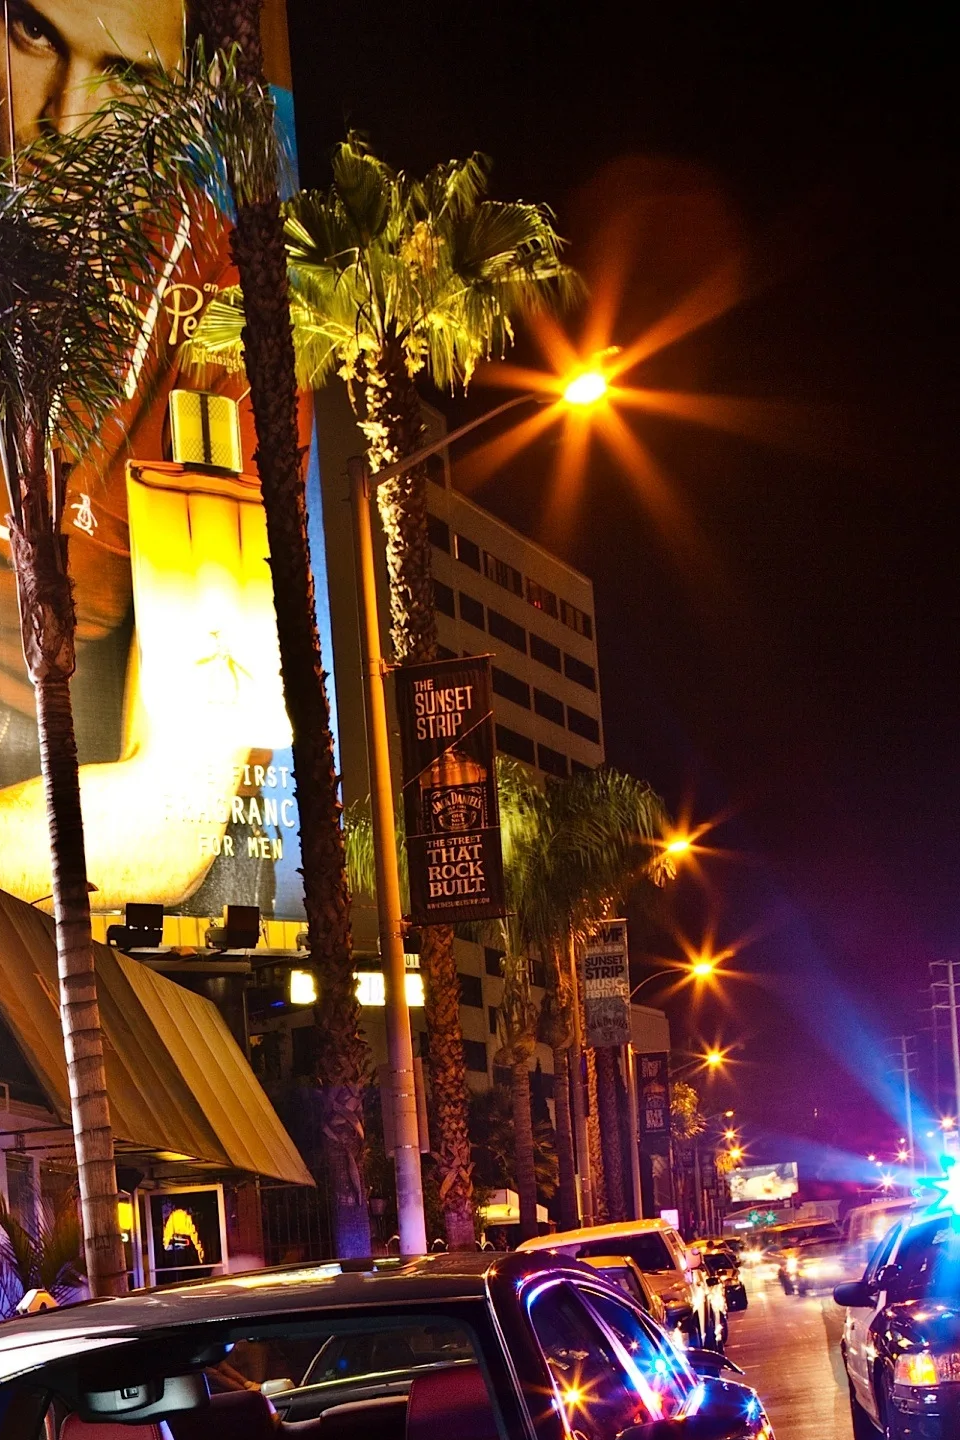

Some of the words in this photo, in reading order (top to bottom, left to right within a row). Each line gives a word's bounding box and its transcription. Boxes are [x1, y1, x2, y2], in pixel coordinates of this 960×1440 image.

[414, 679, 434, 692] THE
[414, 685, 473, 716] SUNSET
[416, 712, 462, 740] STRIP
[247, 836, 284, 860] MEN
[426, 840, 445, 848] THE
[446, 835, 482, 846] STREET
[426, 844, 483, 864] THAT
[428, 861, 484, 881] ROCK
[429, 877, 486, 898] BUILT.
[584, 954, 624, 968] SUNSET
[585, 965, 625, 979] STRIP
[586, 977, 624, 991] MUSIC
[586, 987, 625, 999] FESTIVAL
